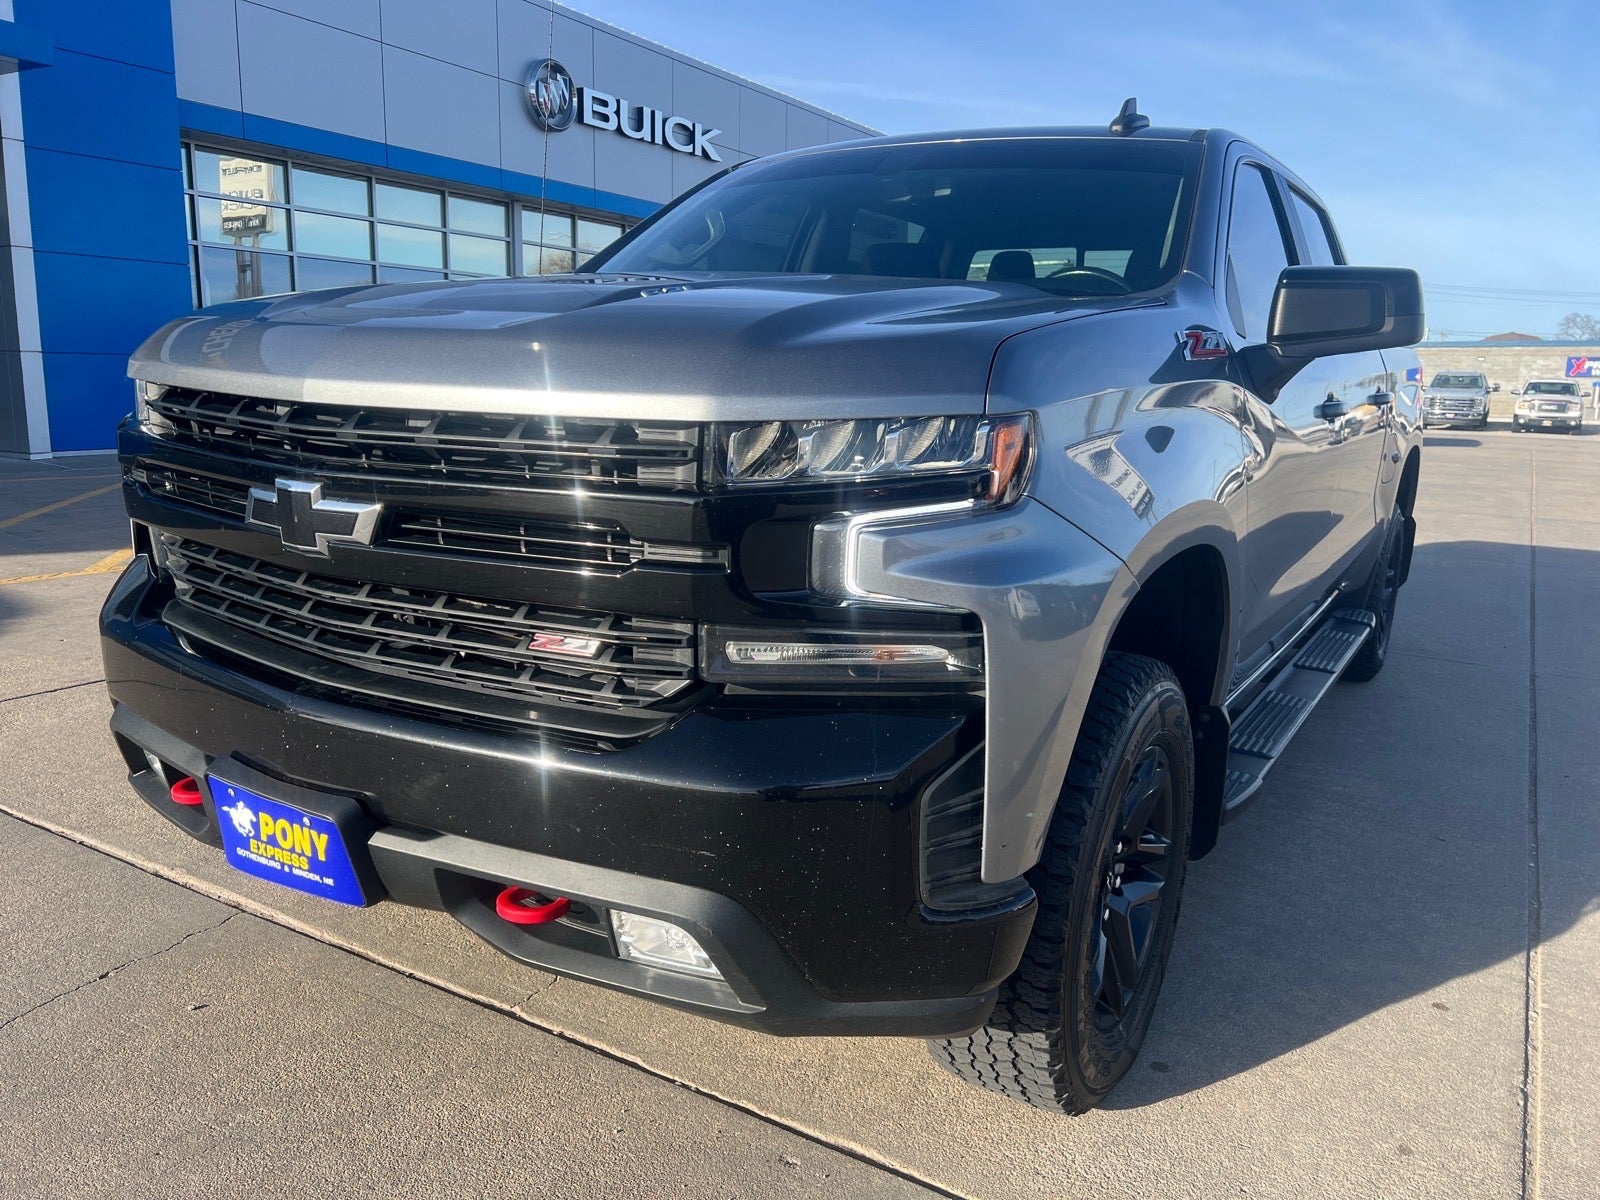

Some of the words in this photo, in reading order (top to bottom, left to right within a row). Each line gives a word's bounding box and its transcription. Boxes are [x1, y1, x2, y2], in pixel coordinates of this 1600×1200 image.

[582, 86, 723, 162] BUICK
[528, 633, 601, 657] Z71
[258, 811, 328, 861] PONY
[236, 847, 281, 870] GOTHENBURG
[283, 864, 290, 873] &
[250, 839, 309, 870] EXPRESS
